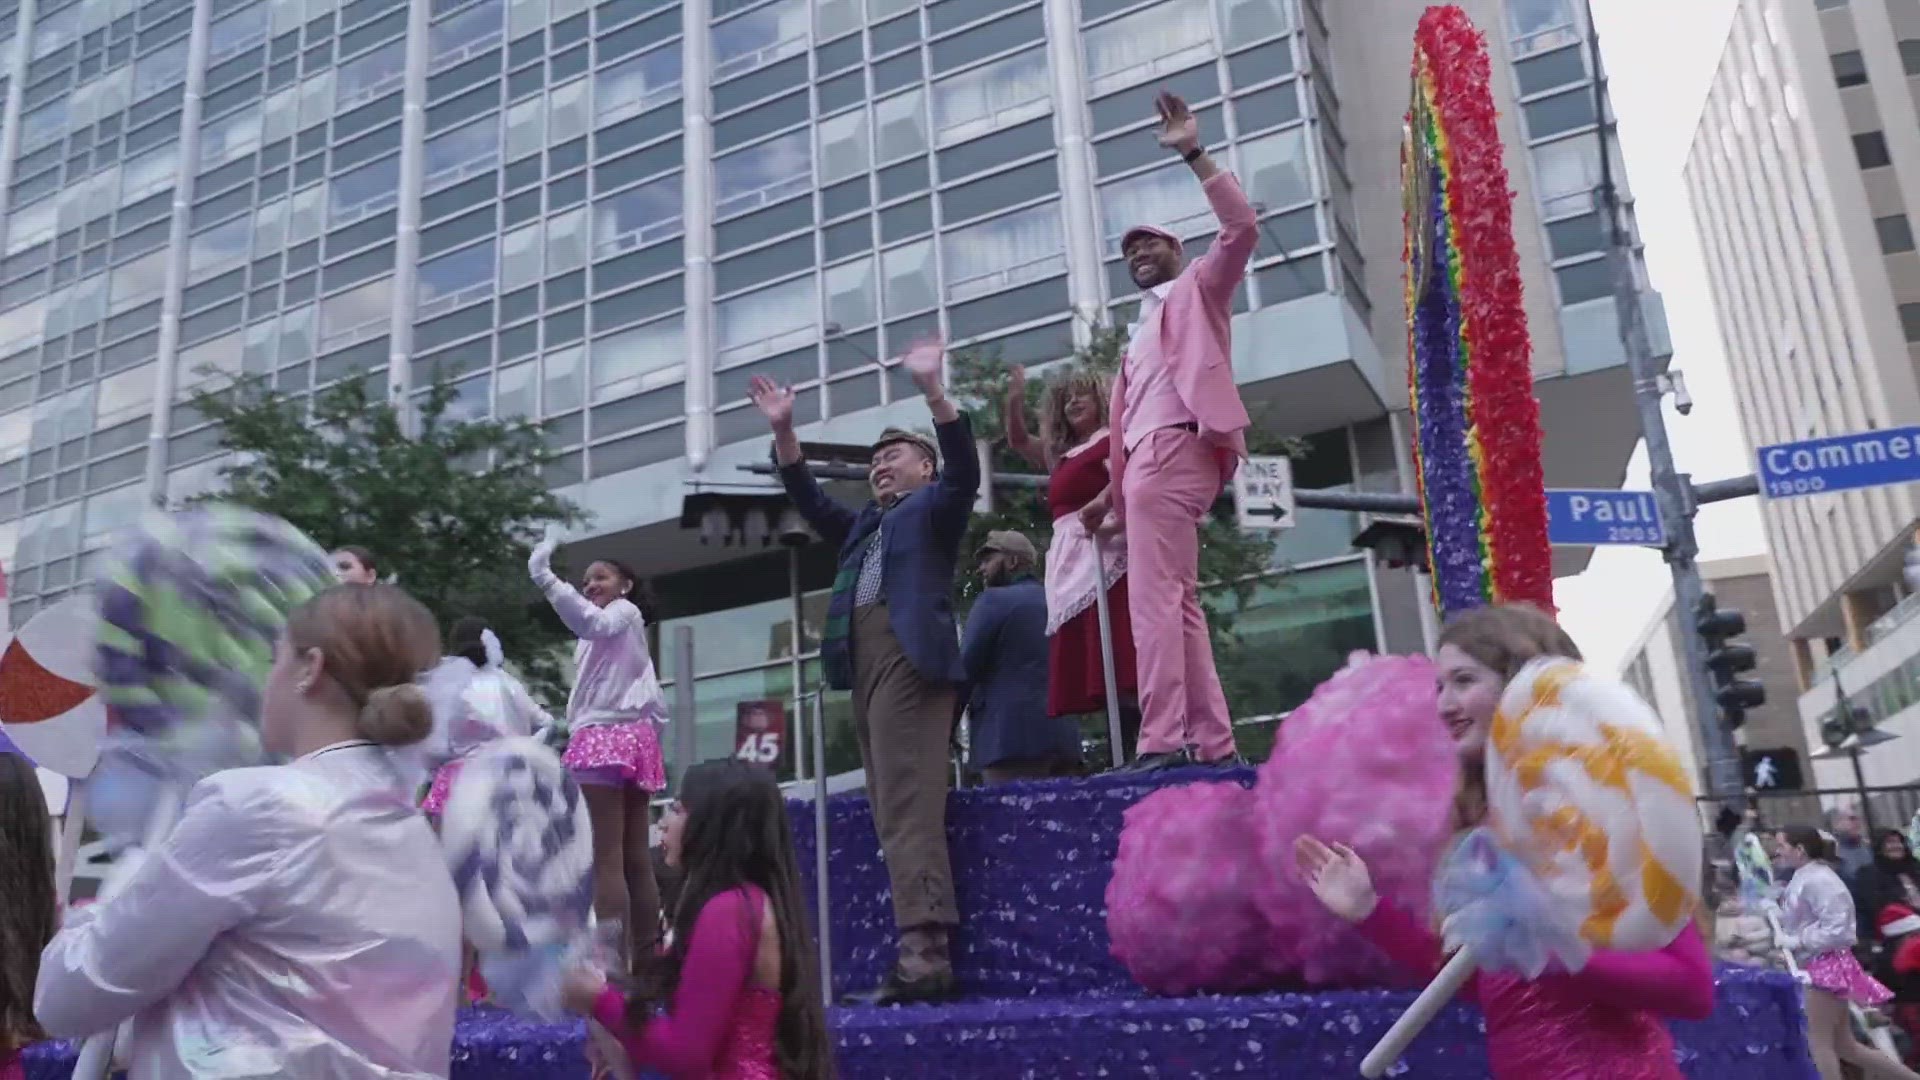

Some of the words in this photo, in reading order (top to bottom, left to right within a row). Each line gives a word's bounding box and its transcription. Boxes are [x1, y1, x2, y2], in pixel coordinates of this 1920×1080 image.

[1243, 463, 1278, 478] ONE
[1246, 482, 1281, 497] WAY
[1769, 476, 1826, 495] 1900
[1569, 494, 1653, 523] Paul
[737, 732, 779, 763] 45
